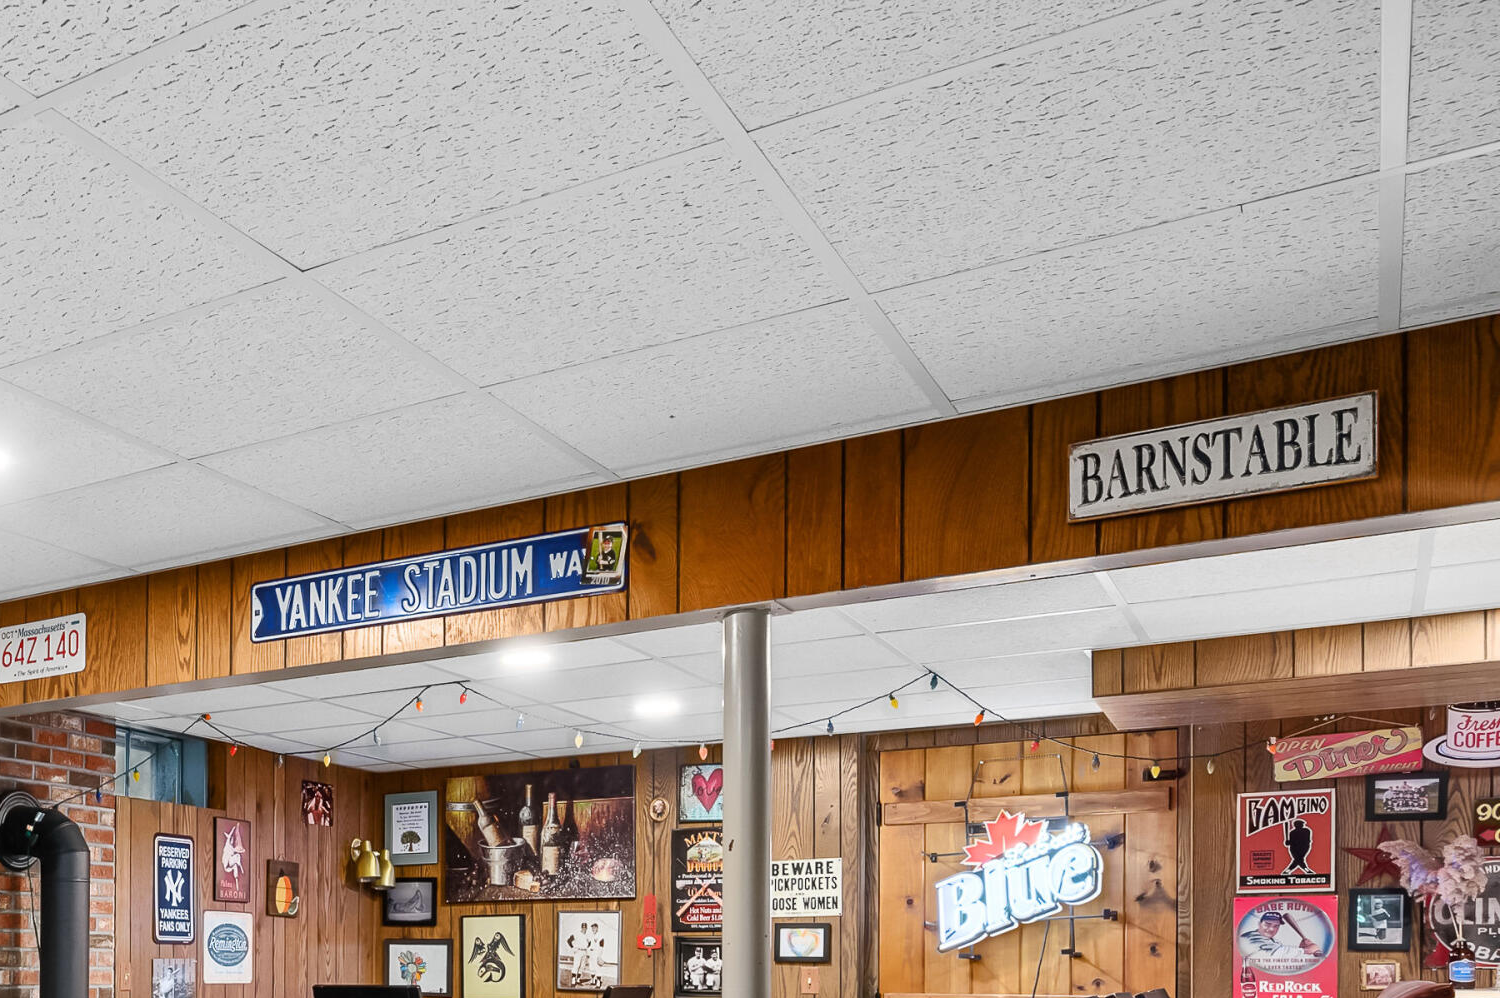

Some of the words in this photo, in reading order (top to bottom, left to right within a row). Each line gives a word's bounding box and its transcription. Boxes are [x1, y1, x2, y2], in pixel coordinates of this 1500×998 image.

[1077, 407, 1362, 507] BARNSTABLE
[275, 570, 381, 632] YANKEE
[401, 545, 534, 613] STADIUM
[2, 632, 14, 640] OCT
[17, 623, 66, 638] Massachusetts
[2, 636, 37, 667] 64Z
[44, 629, 79, 661] 140
[1276, 738, 1326, 754] OPEN
[1283, 729, 1408, 779] Diner
[1246, 796, 1329, 837] BAMBINO
[684, 831, 722, 848] MATT'
[159, 846, 189, 859] RESERVED
[161, 857, 187, 870] PARKING
[772, 861, 834, 876] BEWARE
[1247, 876, 1286, 885] SMOKING
[1288, 876, 1326, 884] TOBACCO
[772, 897, 797, 911] OOSE
[803, 896, 838, 910] WOMEN
[935, 842, 1104, 953] Blue
[160, 908, 189, 920] YANKEES
[1256, 903, 1284, 913] BABE
[1287, 903, 1314, 913] RUTH
[160, 921, 174, 932] FANS
[176, 922, 190, 932] ONLY
[209, 936, 247, 953] Remington
